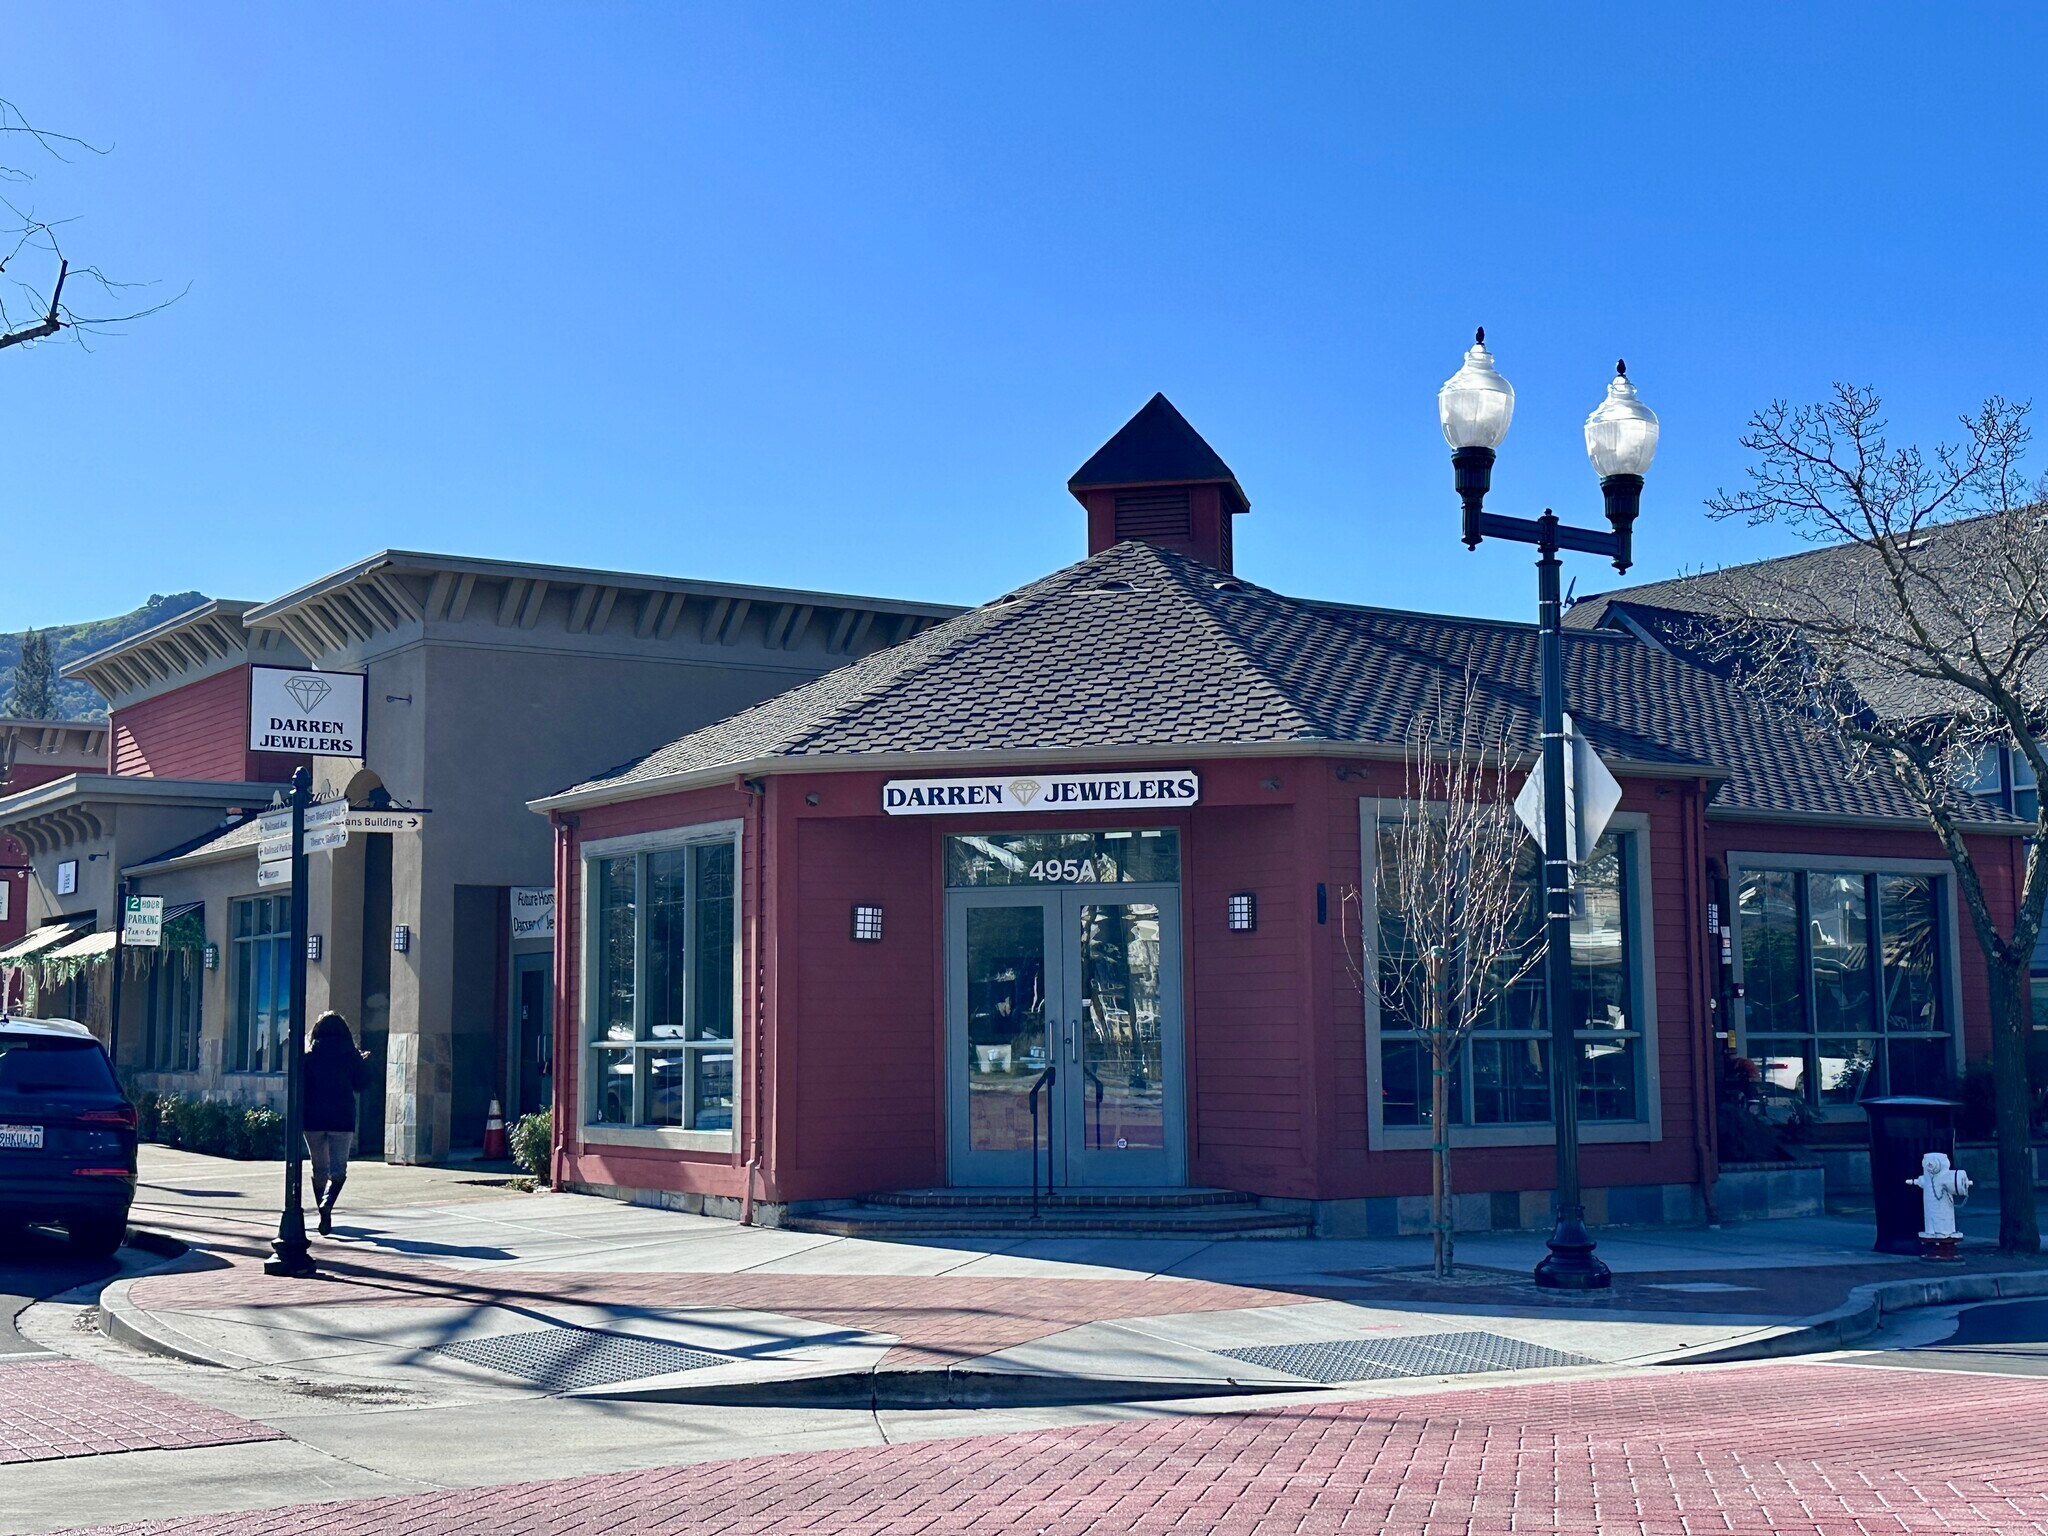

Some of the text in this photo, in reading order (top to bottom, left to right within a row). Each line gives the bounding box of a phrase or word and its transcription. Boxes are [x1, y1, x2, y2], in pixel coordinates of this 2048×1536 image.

[270, 717, 344, 734] DARREN
[259, 734, 353, 752] JEWELERS
[886, 778, 1195, 807] DARREN JEWELERS
[264, 820, 280, 831] Railroad
[364, 817, 403, 829] Building
[279, 842, 292, 853] Parkin
[1029, 859, 1097, 882] 495A
[130, 897, 160, 909] 2 HOUR
[518, 890, 555, 906] Future Hom
[128, 914, 159, 924] PARKING
